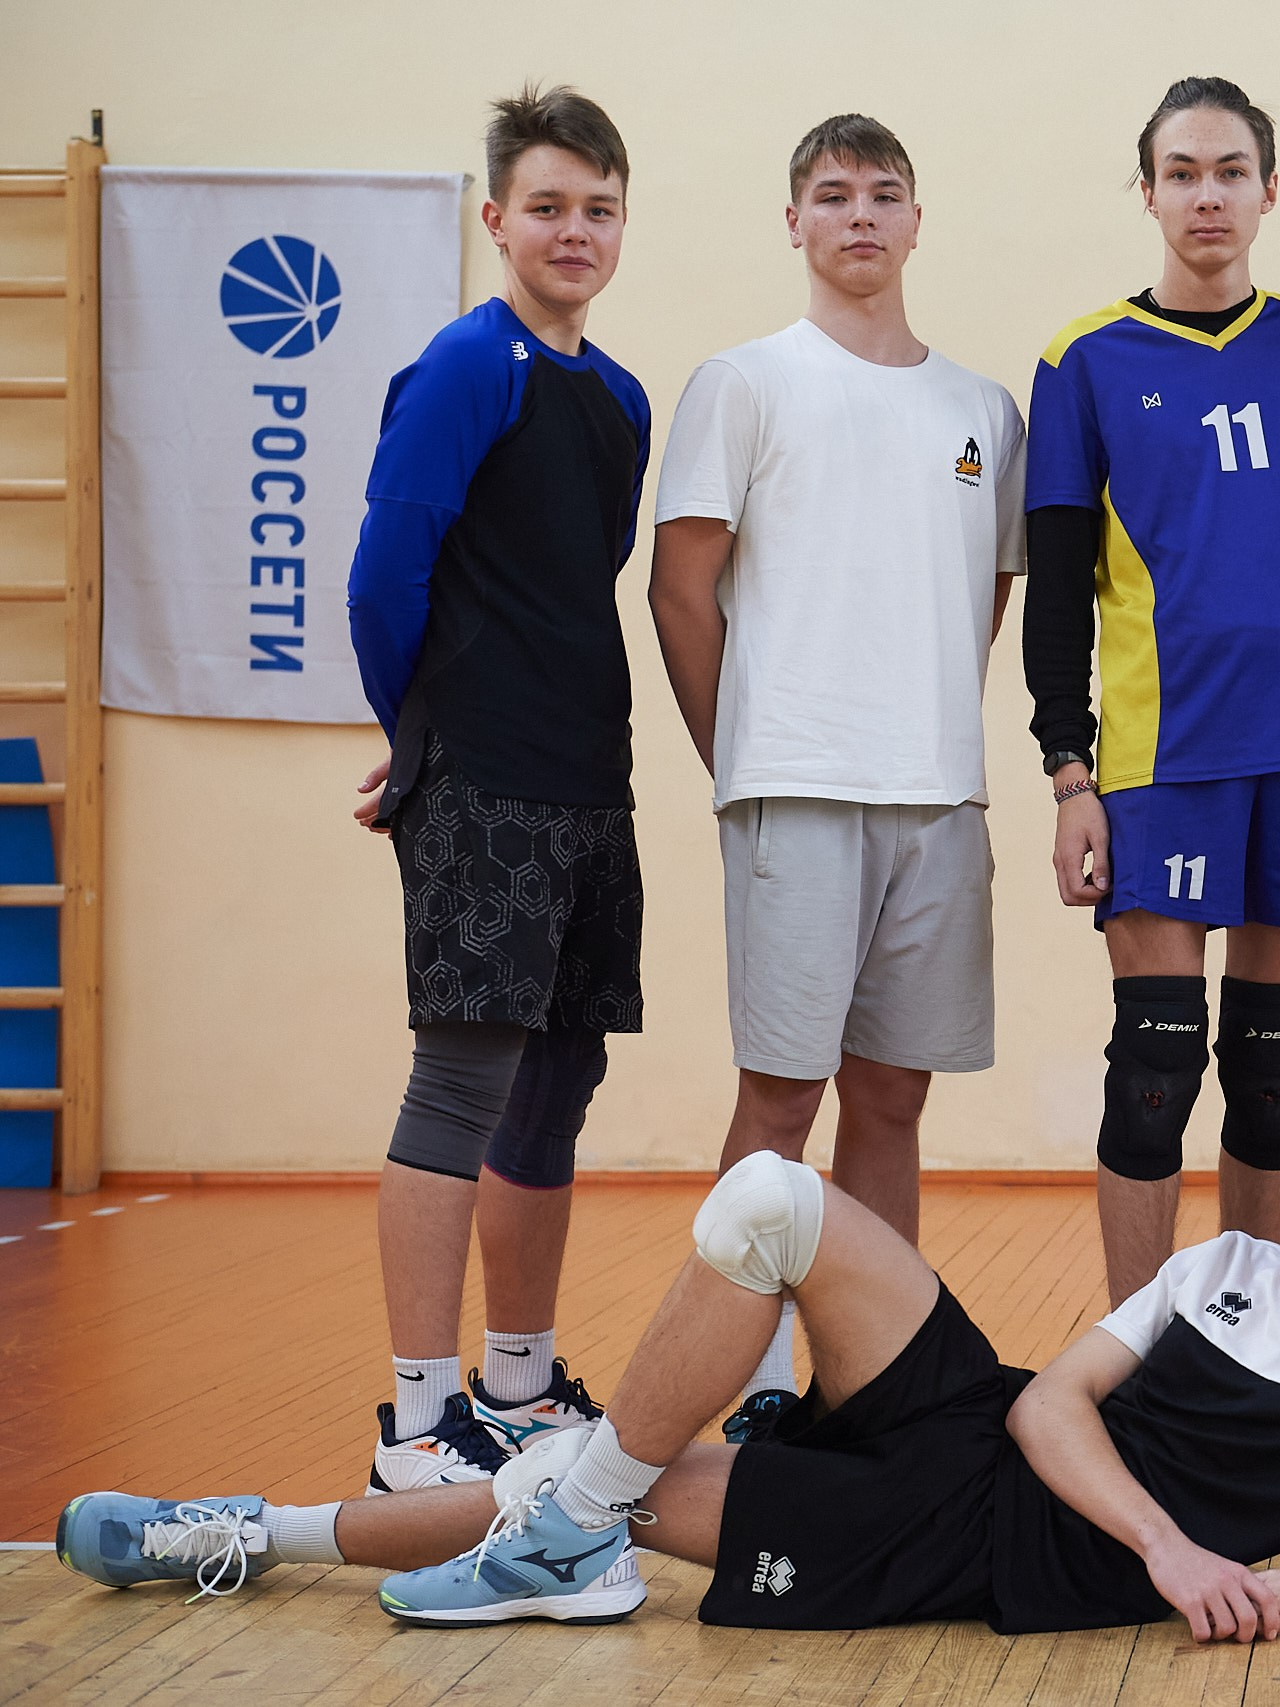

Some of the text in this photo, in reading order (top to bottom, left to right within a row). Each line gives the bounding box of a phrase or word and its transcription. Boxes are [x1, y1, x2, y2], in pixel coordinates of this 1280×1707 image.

[1201, 402, 1270, 471] 11
[250, 385, 307, 672] РОССЕТИ
[1164, 853, 1206, 900] 11
[1155, 1022, 1200, 1032] DEMIX
[1205, 1303, 1240, 1327] errea
[751, 1551, 772, 1593] errea
